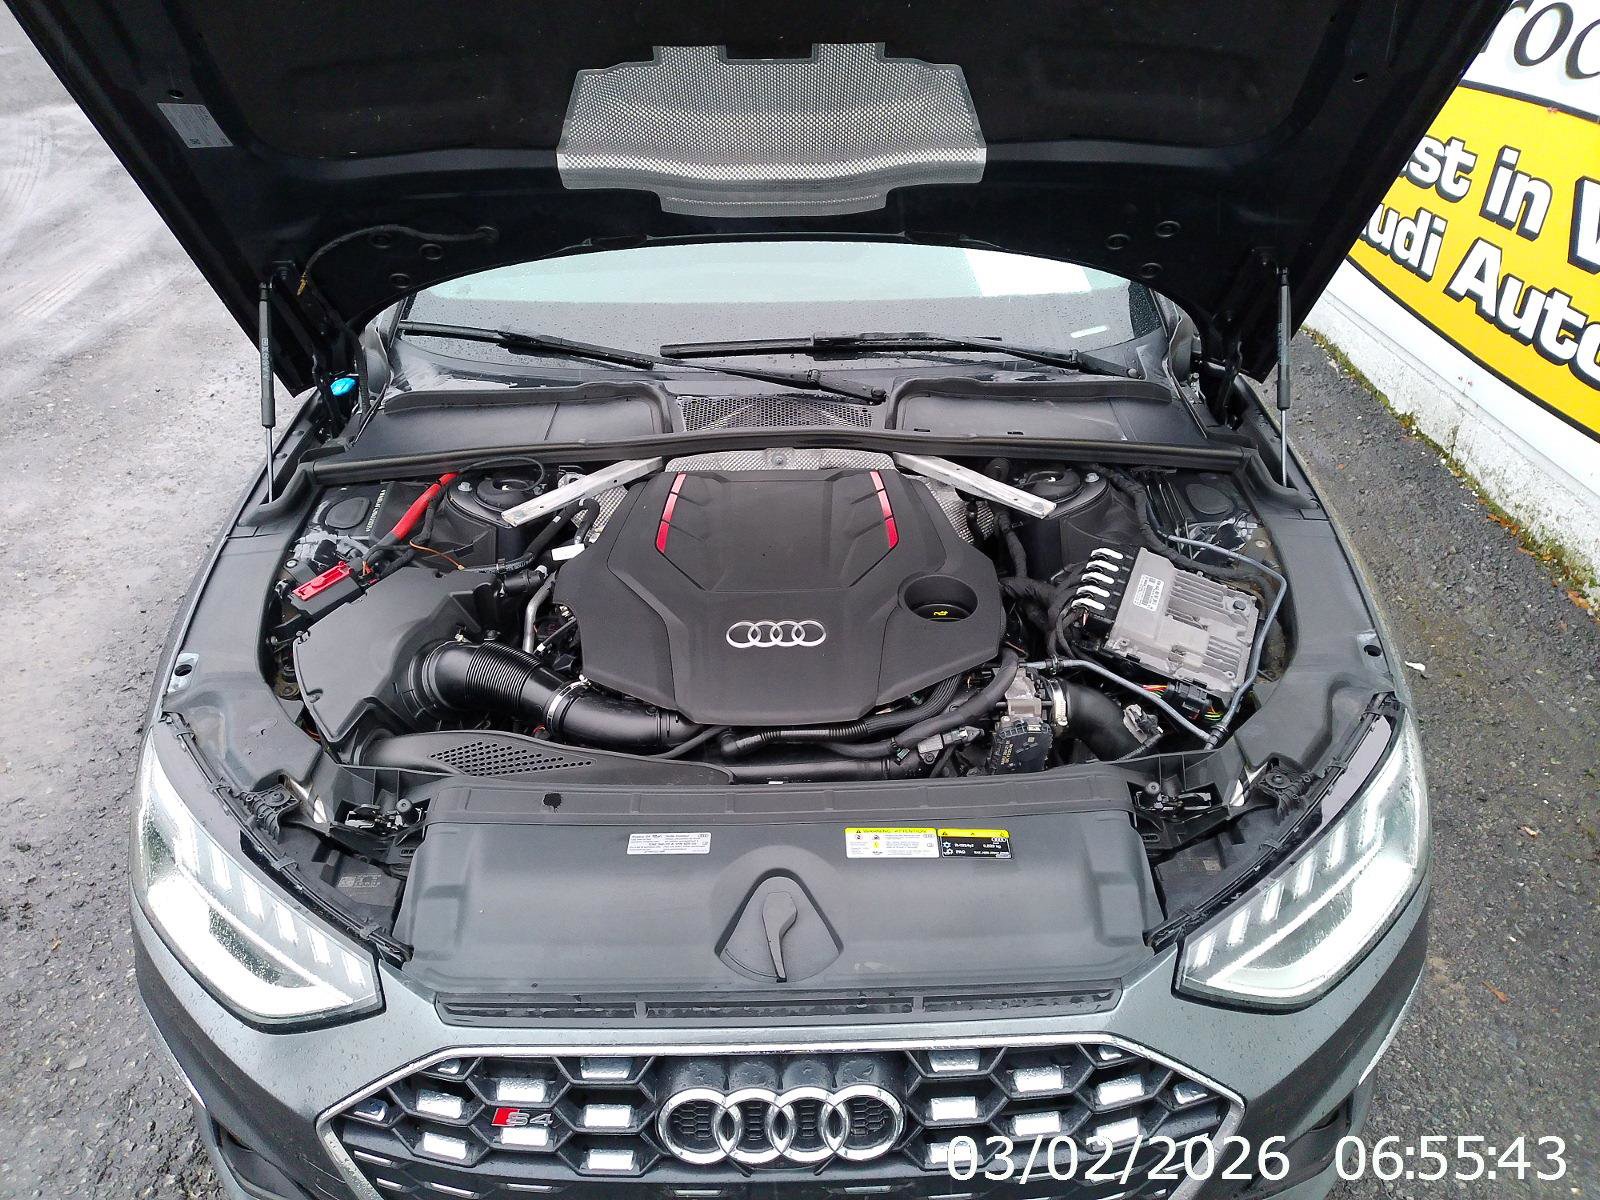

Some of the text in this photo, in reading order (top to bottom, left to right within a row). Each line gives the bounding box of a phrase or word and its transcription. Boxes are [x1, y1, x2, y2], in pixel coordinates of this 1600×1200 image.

[1401, 134, 1478, 203] st
[1479, 144, 1553, 241] in
[1360, 202, 1448, 282] udi
[506, 1111, 553, 1126] S4
